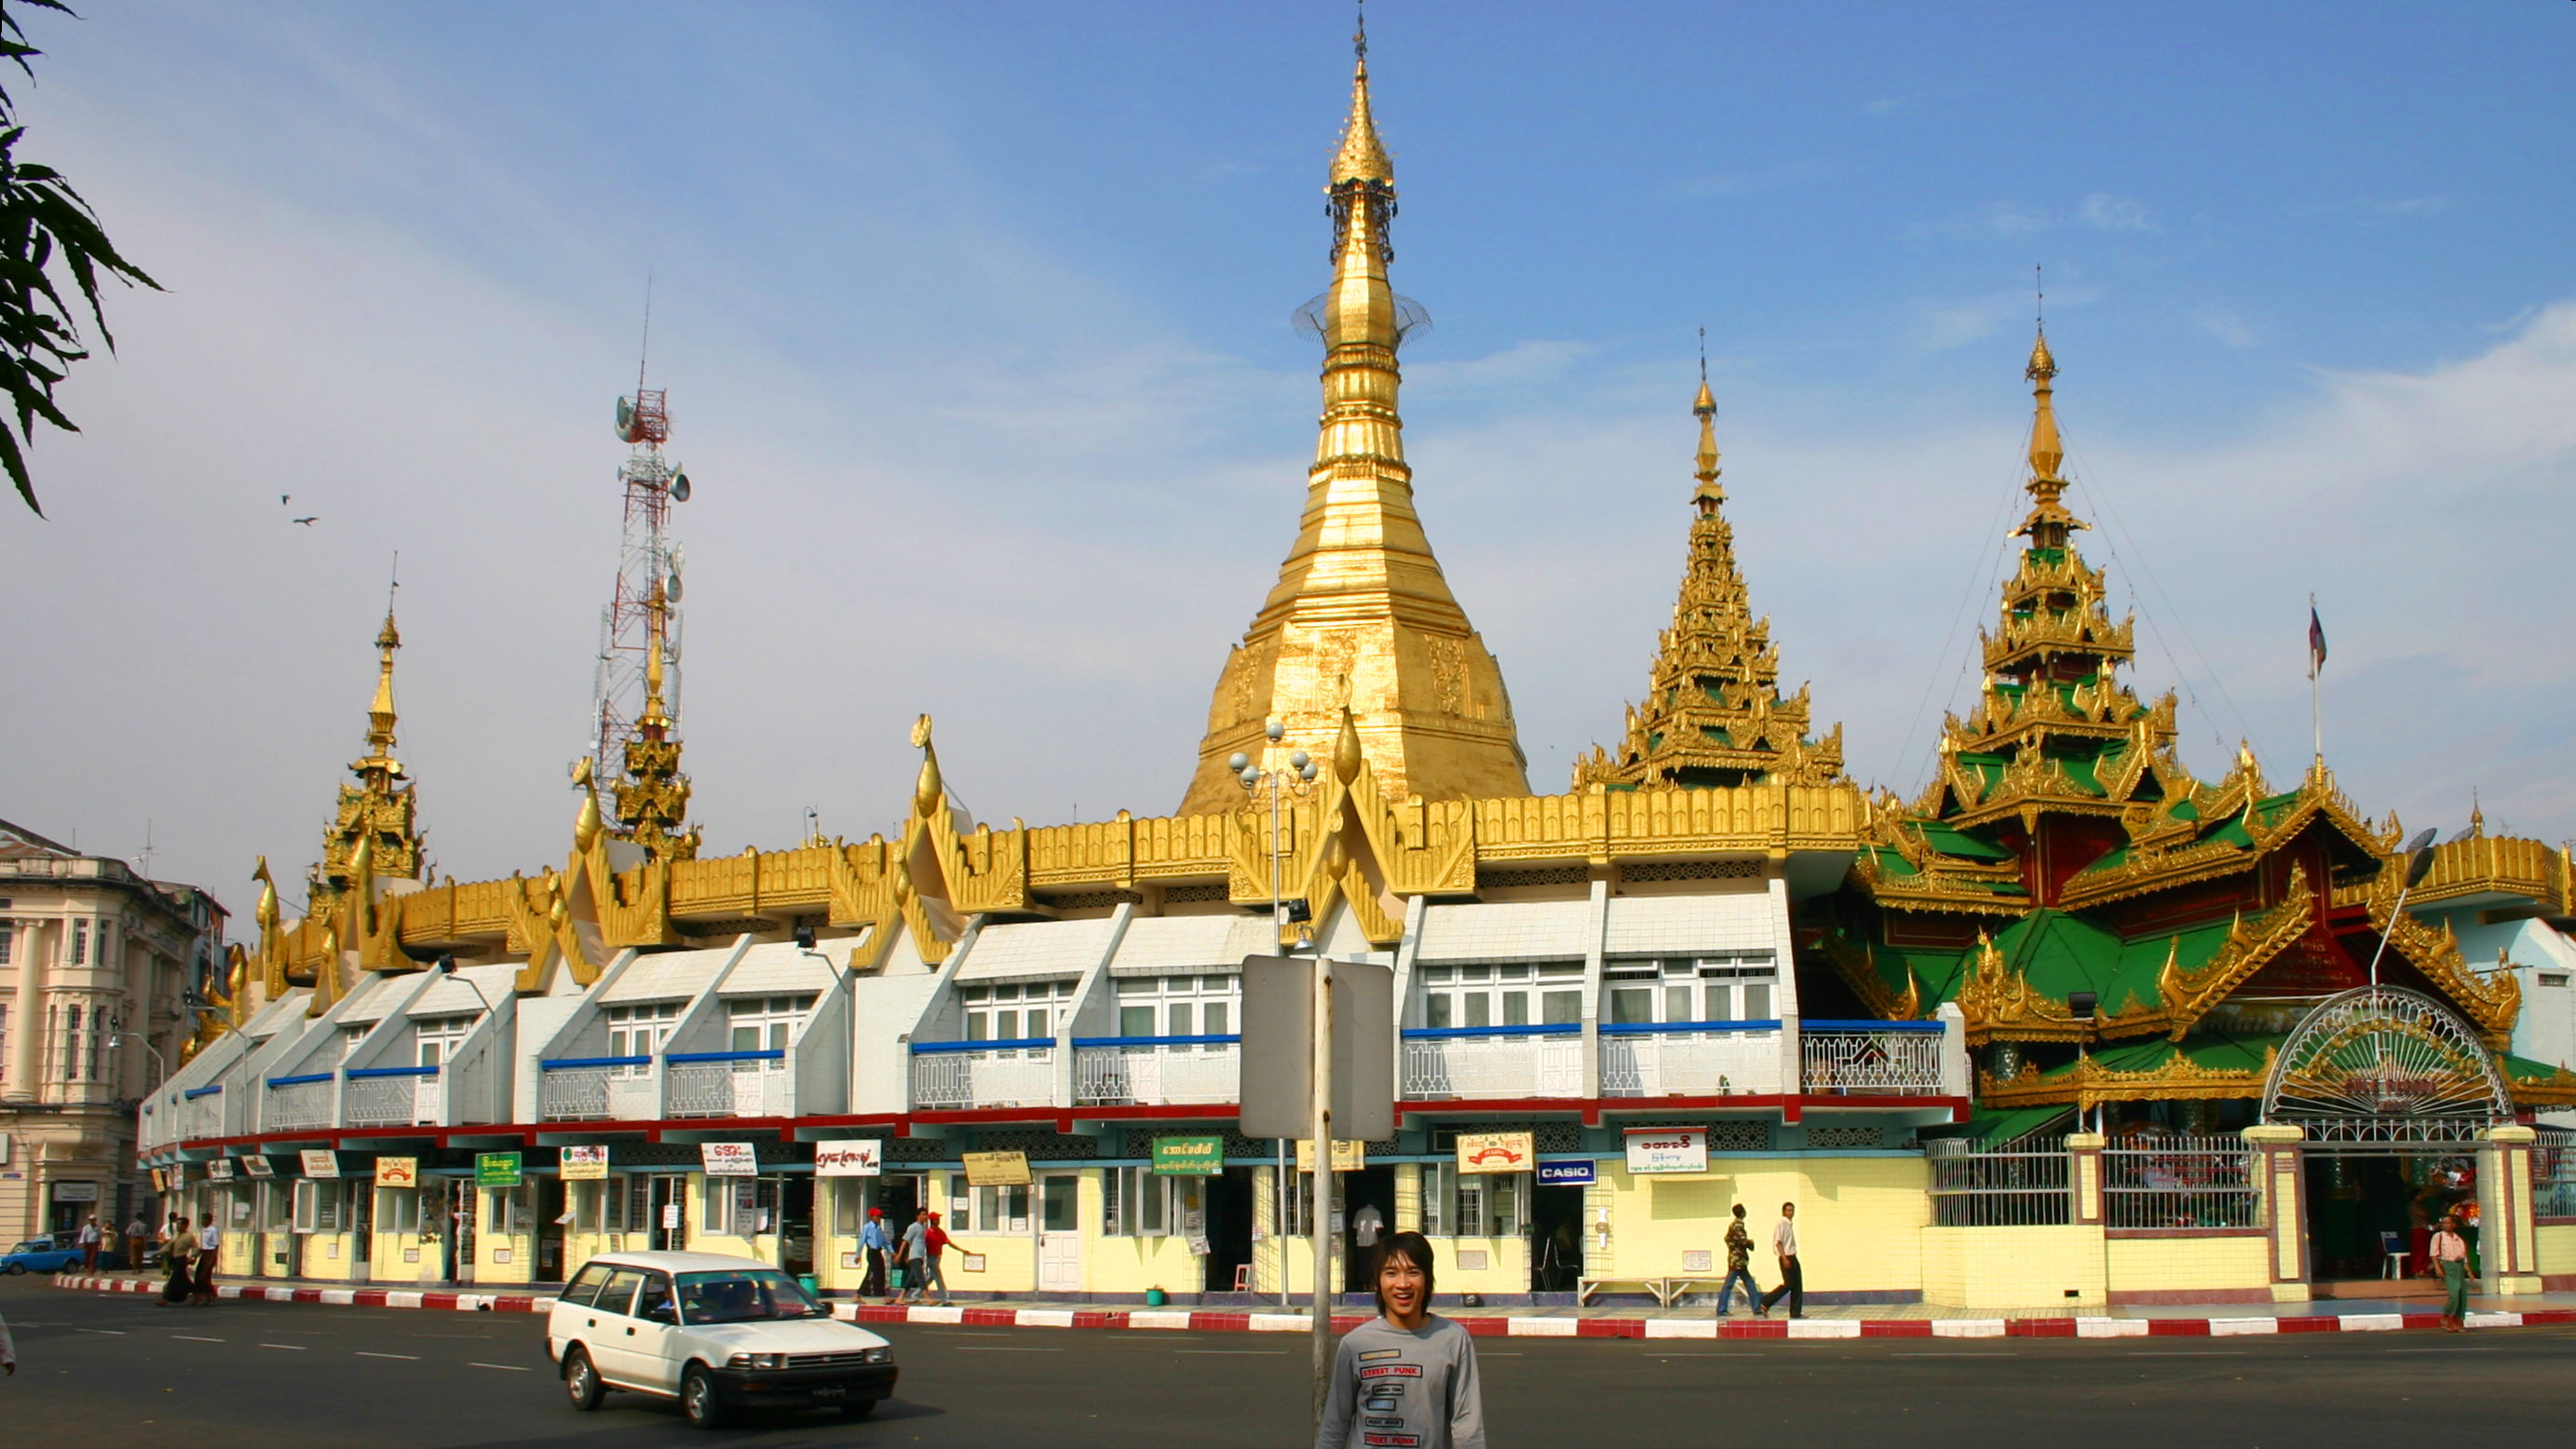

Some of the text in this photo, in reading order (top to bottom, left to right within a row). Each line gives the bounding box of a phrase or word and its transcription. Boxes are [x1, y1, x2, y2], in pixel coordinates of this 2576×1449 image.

[1541, 1167, 1589, 1178] CASIO
[1363, 1367, 1389, 1377] STREET
[1365, 1435, 1416, 1444] STREET PUNK
